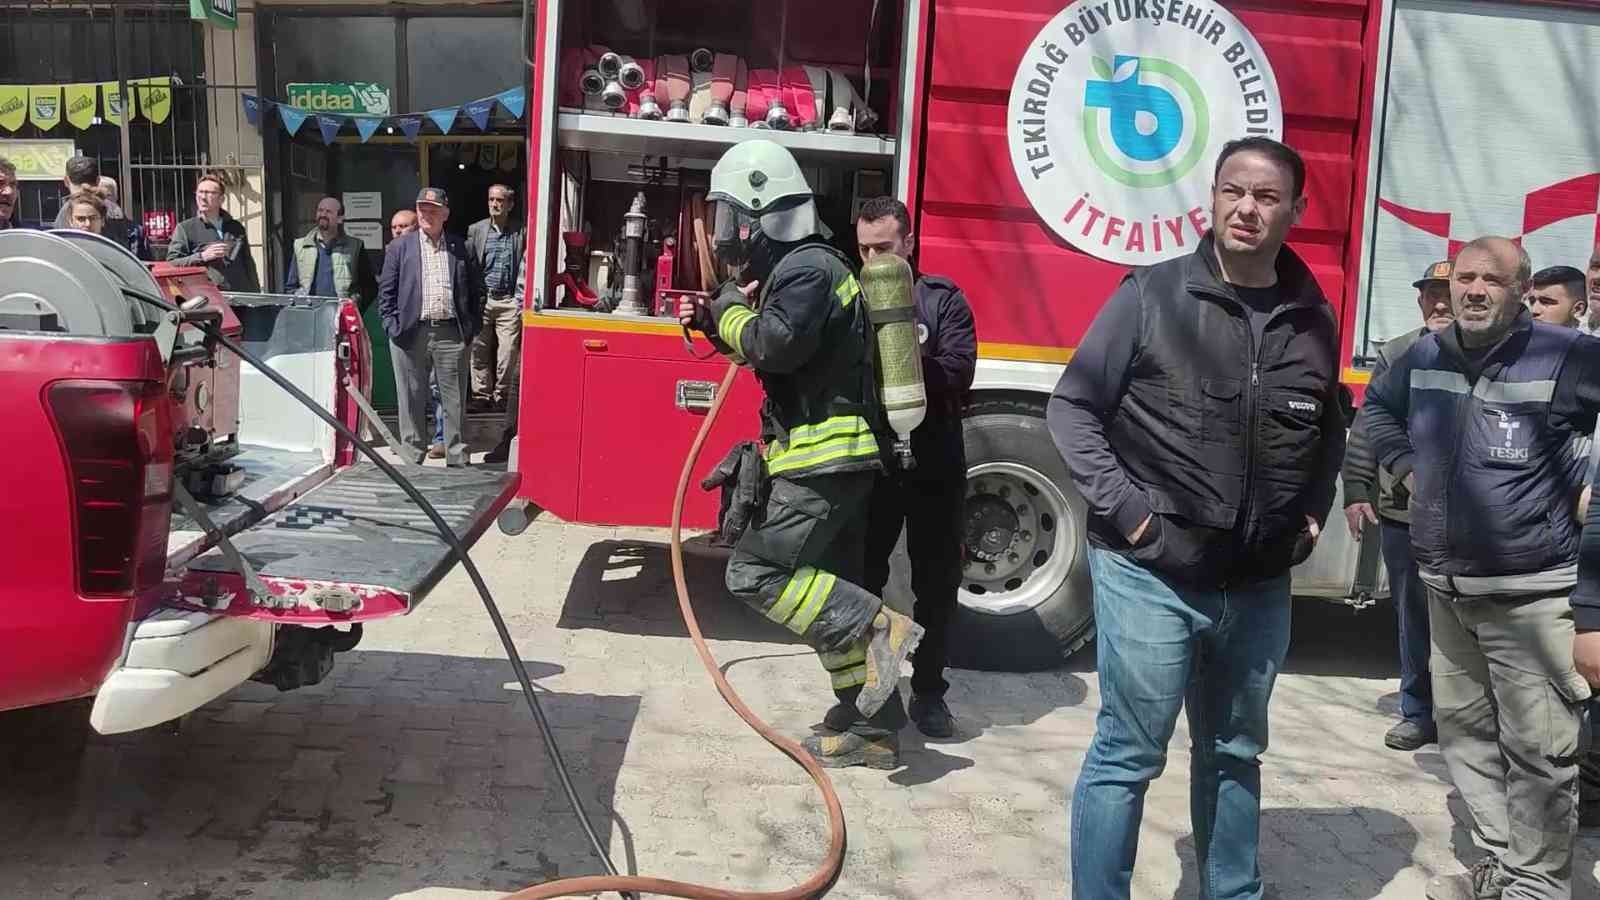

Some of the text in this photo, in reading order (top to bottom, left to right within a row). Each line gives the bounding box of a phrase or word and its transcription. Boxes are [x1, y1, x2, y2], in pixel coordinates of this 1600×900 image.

[290, 90, 354, 111] iddaa
[1017, 0, 1274, 180] TEKİRDAĞ BÜYÜKŞEHİR BELEDİ
[1063, 192, 1210, 252] İTFAİYE
